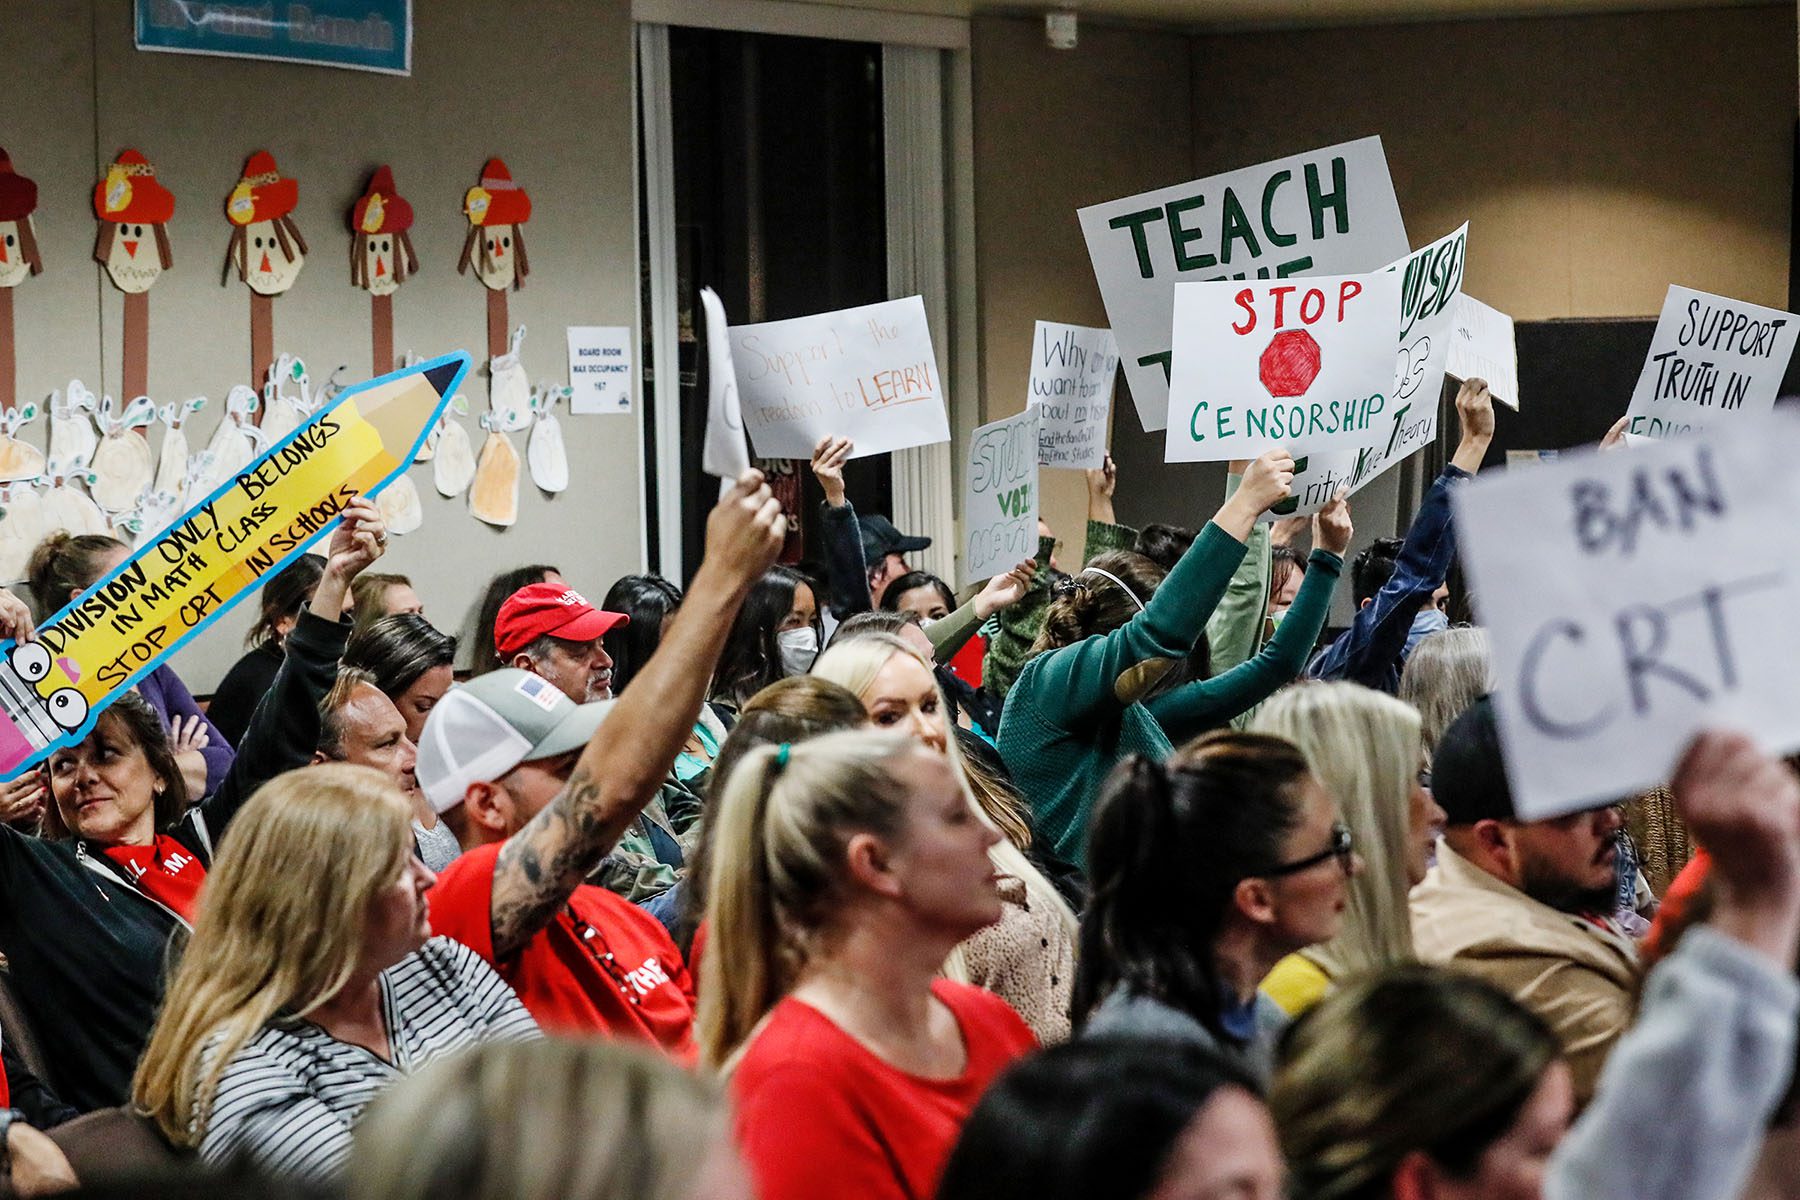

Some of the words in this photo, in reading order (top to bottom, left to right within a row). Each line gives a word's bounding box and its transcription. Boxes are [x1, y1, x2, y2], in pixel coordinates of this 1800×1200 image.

[1109, 156, 1350, 279] TEACH
[1232, 280, 1362, 336] STOP
[1678, 298, 1787, 358] SUPPORT
[579, 348, 600, 356] BOARD
[602, 348, 622, 356] ROOM
[588, 364, 628, 373] OCCUPANCY
[1043, 328, 1087, 378] Why
[1653, 350, 1719, 406] TRUTH
[1721, 371, 1752, 410] IN
[857, 361, 933, 409] LEARN
[1033, 376, 1076, 396] want
[1190, 392, 1385, 443] CENSORSHIP
[1383, 403, 1433, 460] Theory
[1571, 445, 1725, 557] BAN
[39, 560, 148, 655] DIVISION
[156, 501, 219, 564] ONLY
[236, 413, 340, 501] BELONGS
[97, 625, 167, 690] STOP
[180, 582, 223, 628] CRT
[246, 550, 274, 579] IN
[269, 484, 360, 552] SCHOOLS
[111, 611, 142, 636] IN
[140, 553, 207, 609] MATH
[216, 502, 278, 554] CLASS
[1516, 570, 1784, 741] CRT
